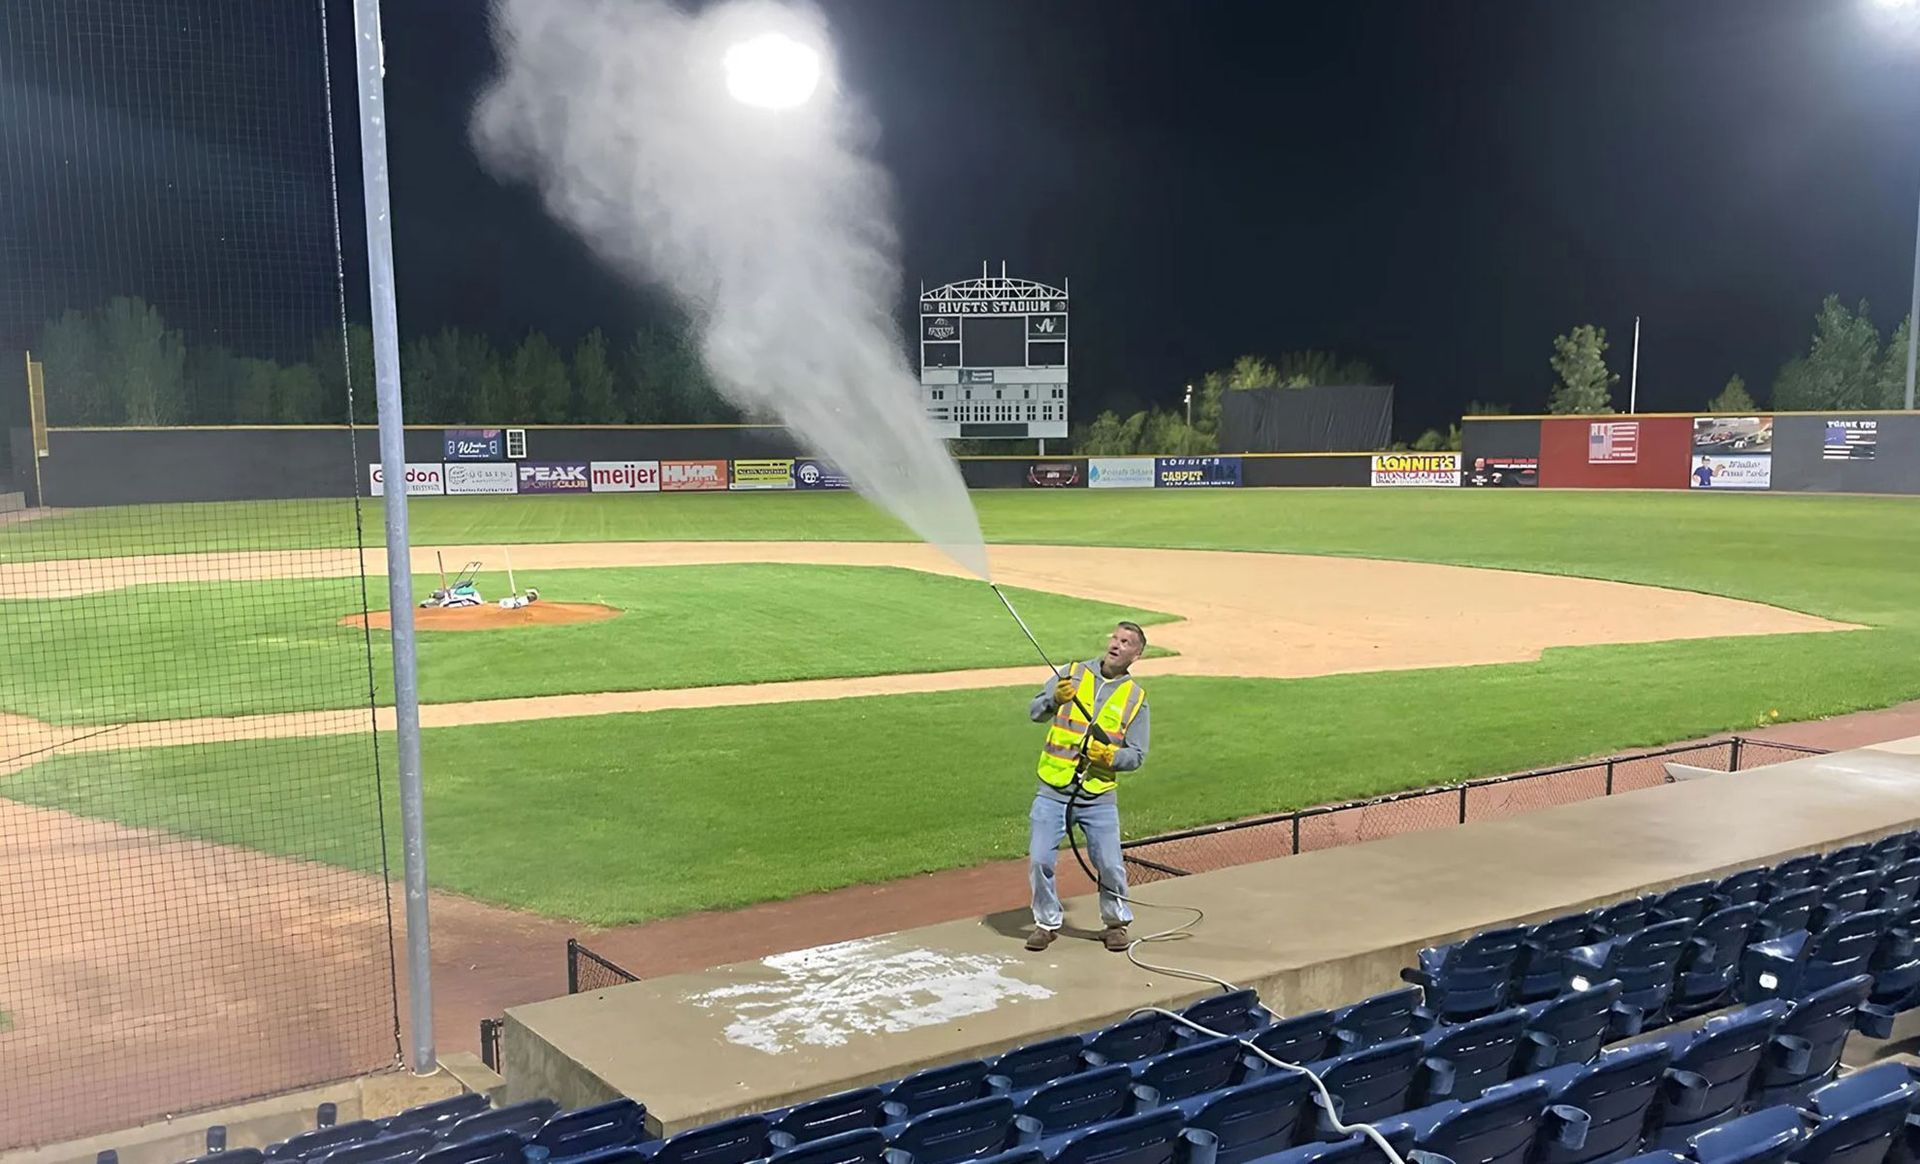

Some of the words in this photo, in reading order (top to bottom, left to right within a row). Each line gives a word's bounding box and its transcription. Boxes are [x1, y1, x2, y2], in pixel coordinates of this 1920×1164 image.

[938, 301, 988, 313] RIVETS
[992, 301, 1051, 313] STADIUM
[1827, 420, 1858, 429] THANK
[1859, 421, 1877, 429] YOU
[1375, 455, 1456, 472] LONNIE'S
[373, 468, 440, 482] Gdon
[520, 466, 588, 481] PEAK
[593, 464, 657, 488] meijer
[1161, 470, 1204, 481] CARPET
